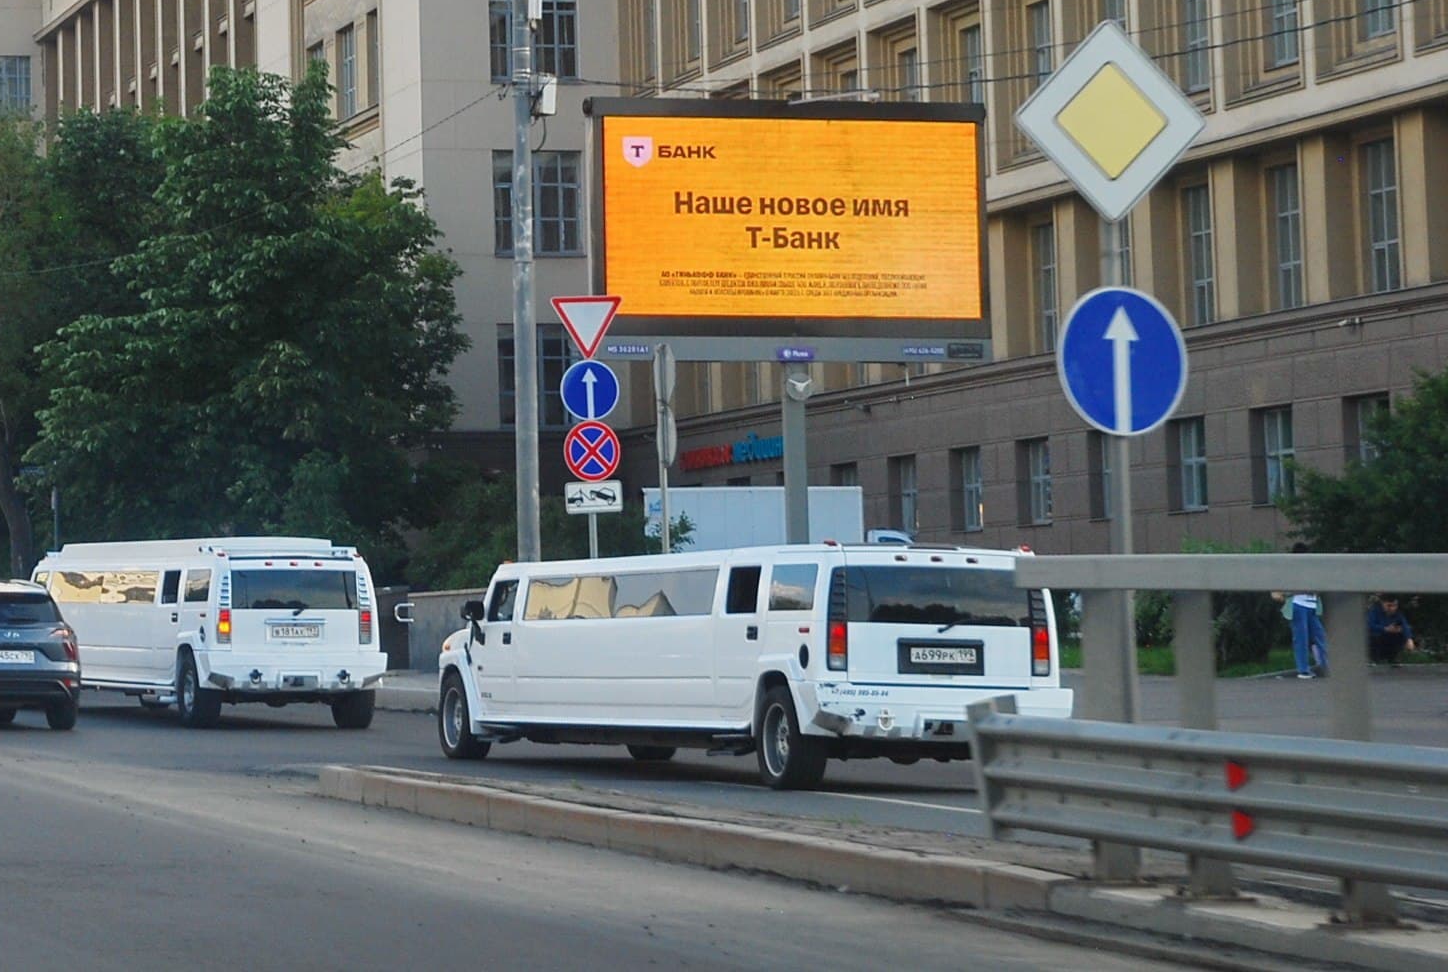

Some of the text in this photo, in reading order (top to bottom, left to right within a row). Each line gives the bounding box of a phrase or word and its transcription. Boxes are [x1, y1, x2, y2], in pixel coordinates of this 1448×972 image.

[631, 145, 716, 159] Т БАНК
[674, 191, 909, 217] Наше новое имя
[745, 226, 840, 249] Т-Банк
